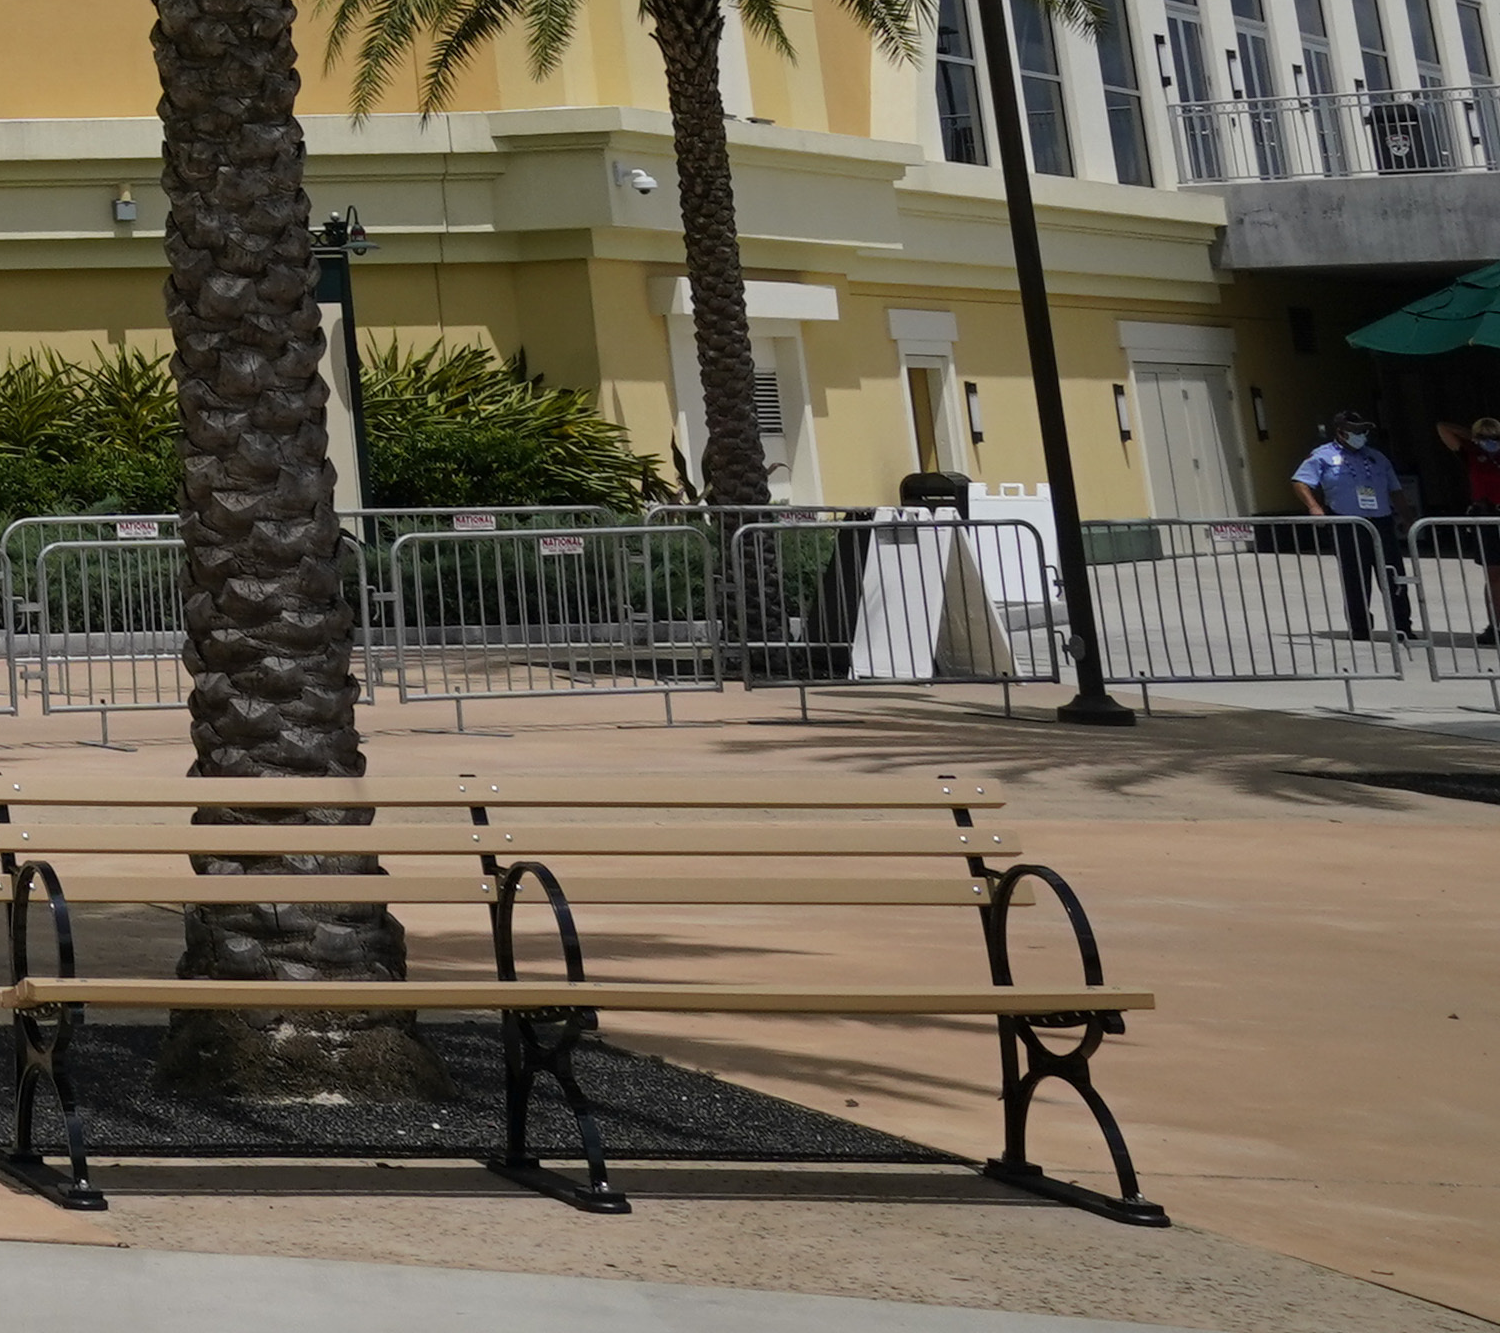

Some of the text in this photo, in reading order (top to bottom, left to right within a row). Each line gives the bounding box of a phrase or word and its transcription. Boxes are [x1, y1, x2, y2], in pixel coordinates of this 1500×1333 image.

[455, 514, 493, 524] NATIONAL
[778, 512, 817, 521] NATIONAL
[1214, 524, 1251, 534] NATIONAL
[542, 537, 582, 546] NATIONAL
